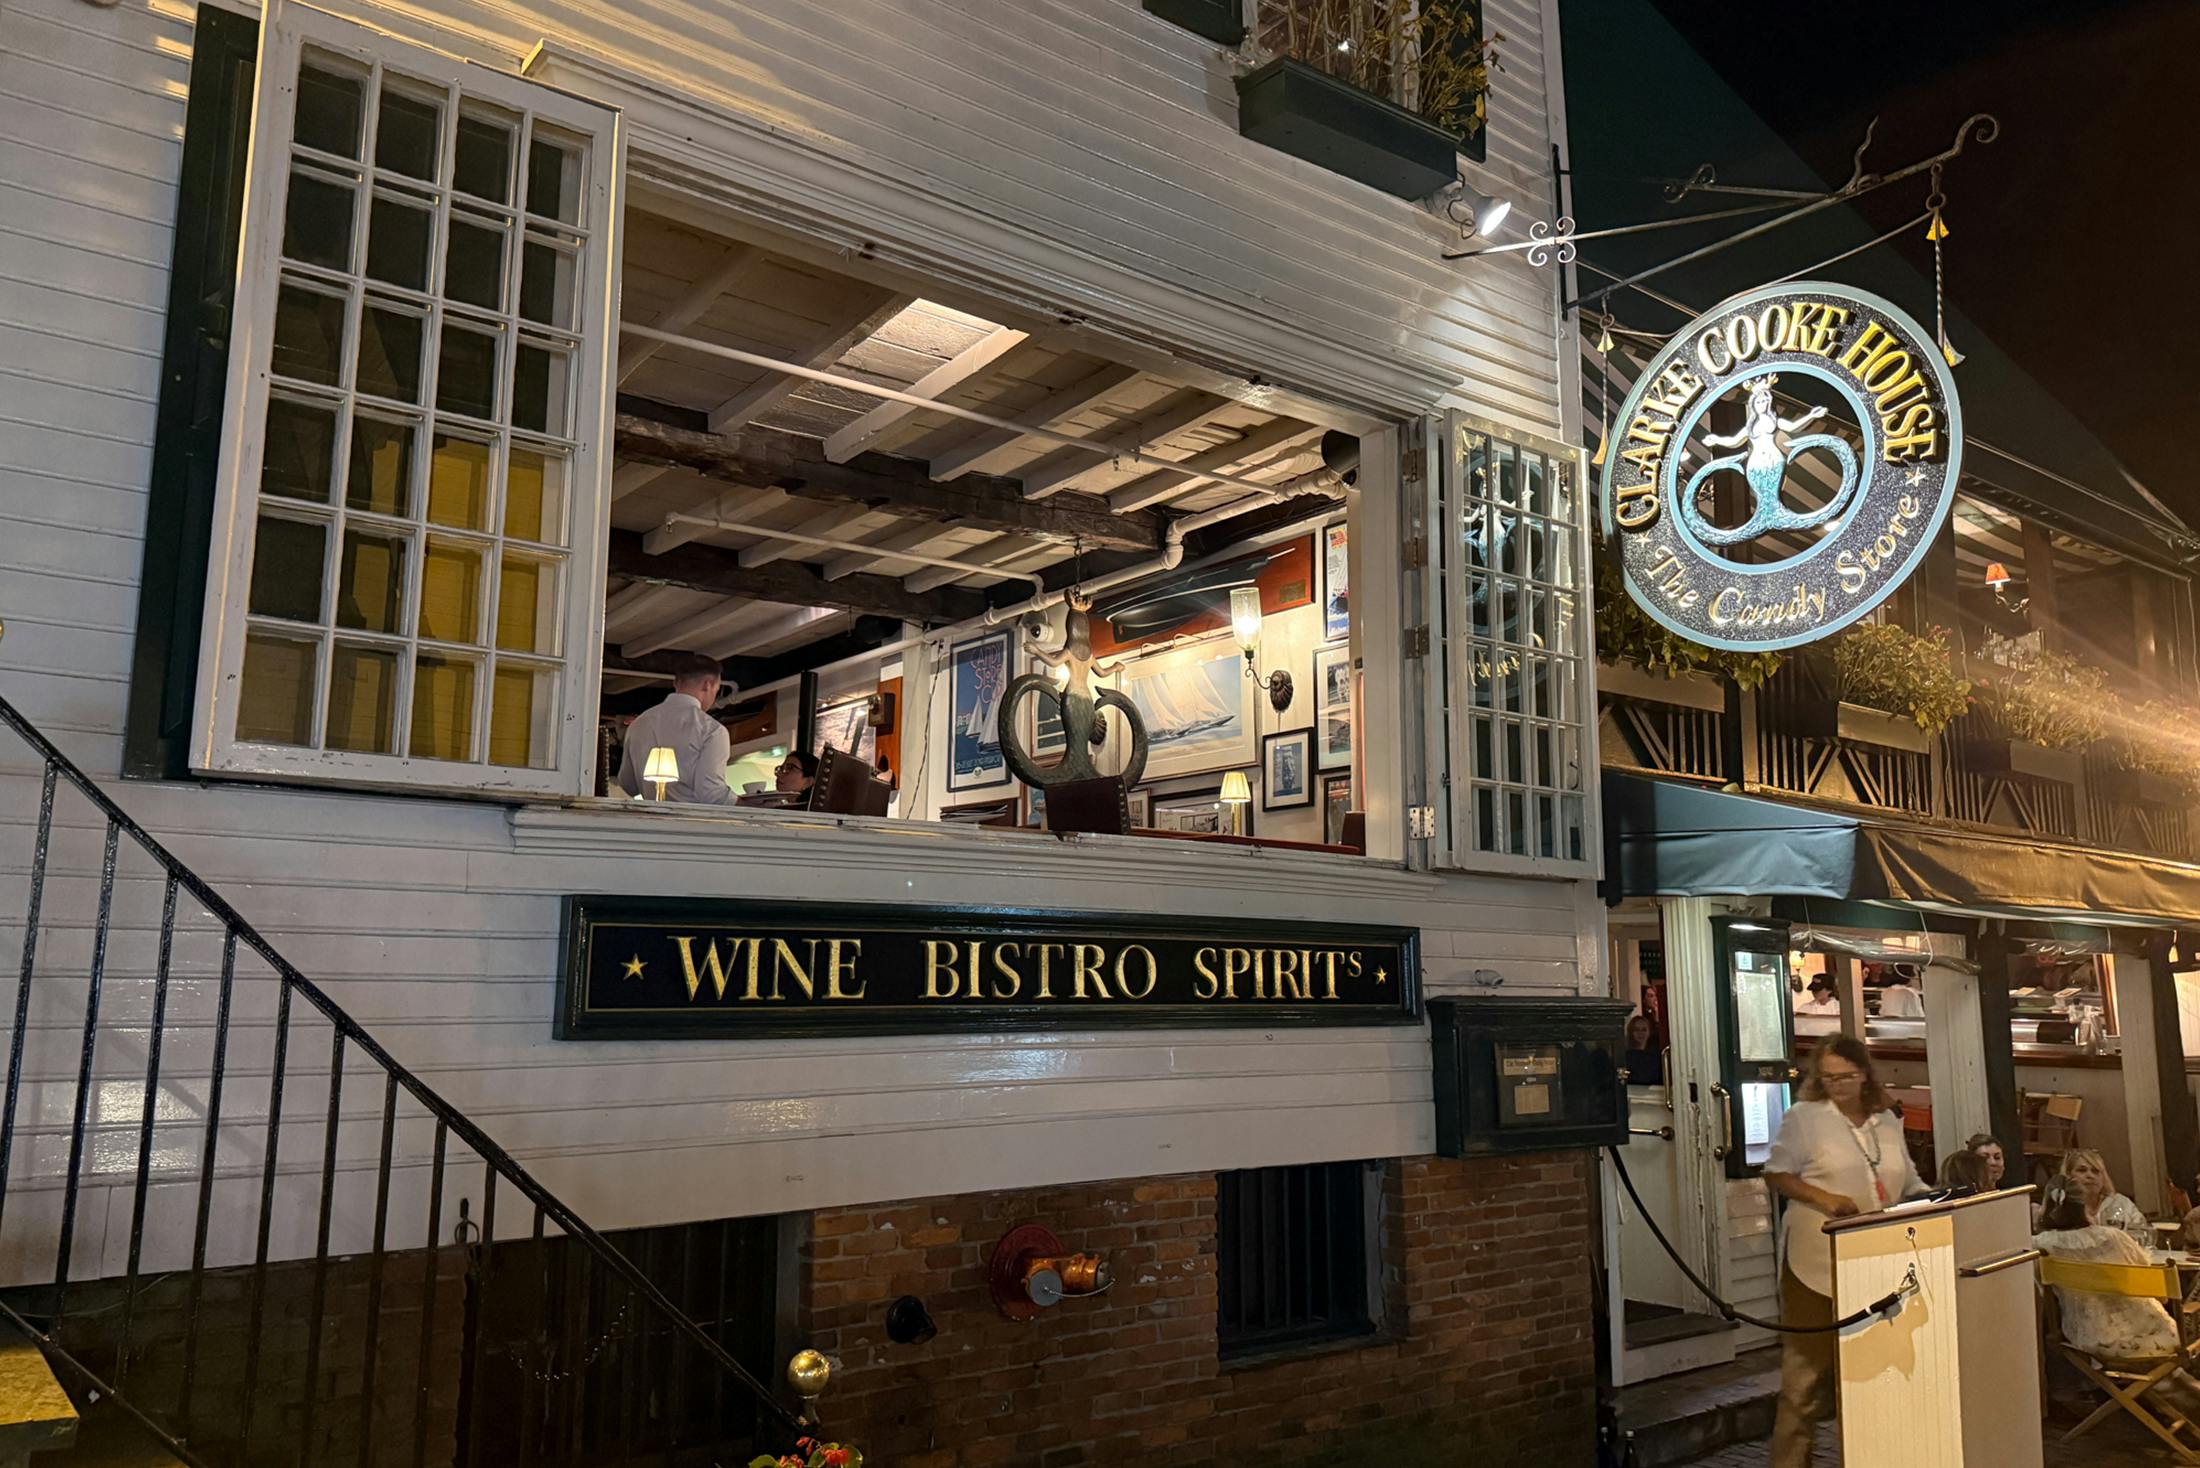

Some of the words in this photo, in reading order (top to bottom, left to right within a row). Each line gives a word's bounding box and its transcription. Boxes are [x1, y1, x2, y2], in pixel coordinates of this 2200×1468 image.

[1616, 358, 1705, 527] CLARKE
[1697, 302, 1849, 375] COOKE
[1837, 319, 1938, 464] HOUSE
[1643, 546, 1699, 609] The
[1709, 583, 1828, 626] Candy
[1836, 493, 1921, 595] Store
[667, 936, 868, 1001] WINE
[918, 939, 1158, 999] BISTRO
[1192, 946, 1363, 999] SPIRITS
